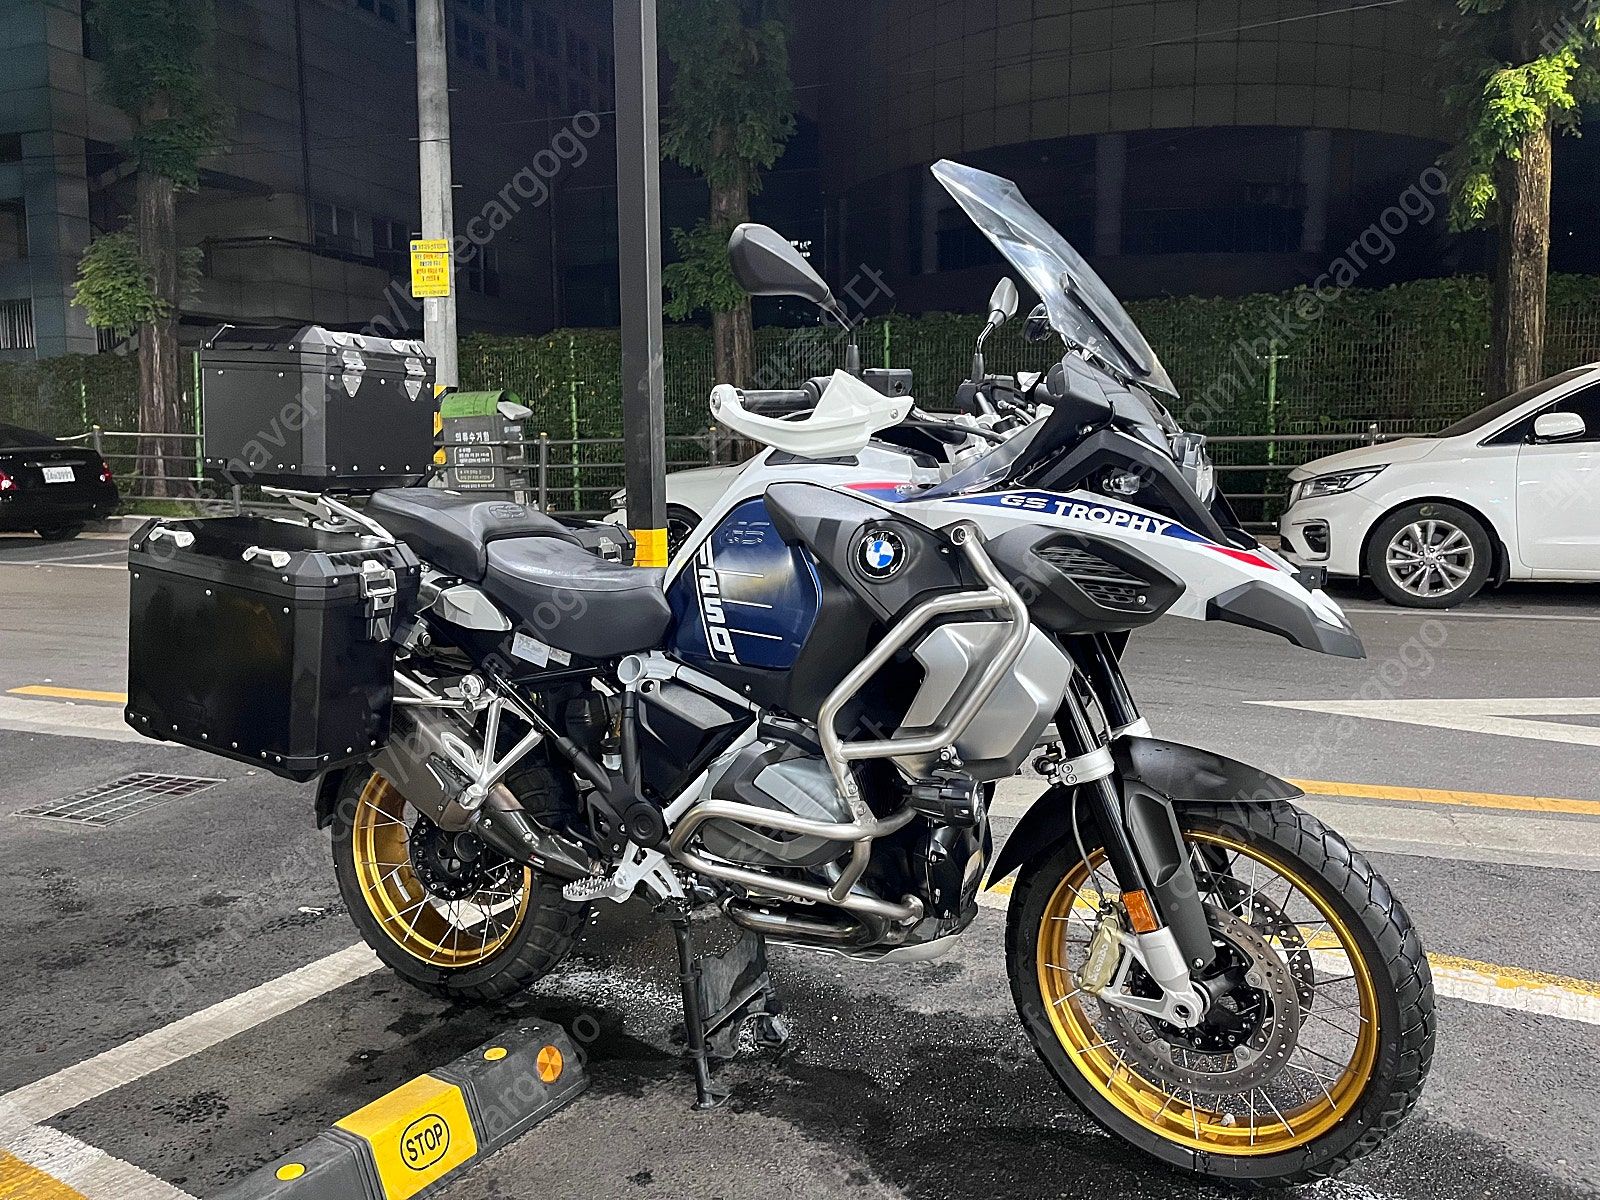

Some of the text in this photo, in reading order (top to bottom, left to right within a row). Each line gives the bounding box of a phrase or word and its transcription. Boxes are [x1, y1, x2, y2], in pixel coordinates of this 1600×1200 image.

[455, 431, 490, 442] 의류수거함
[1000, 494, 1172, 536] GS TROPHY
[406, 1123, 443, 1162] STOP
